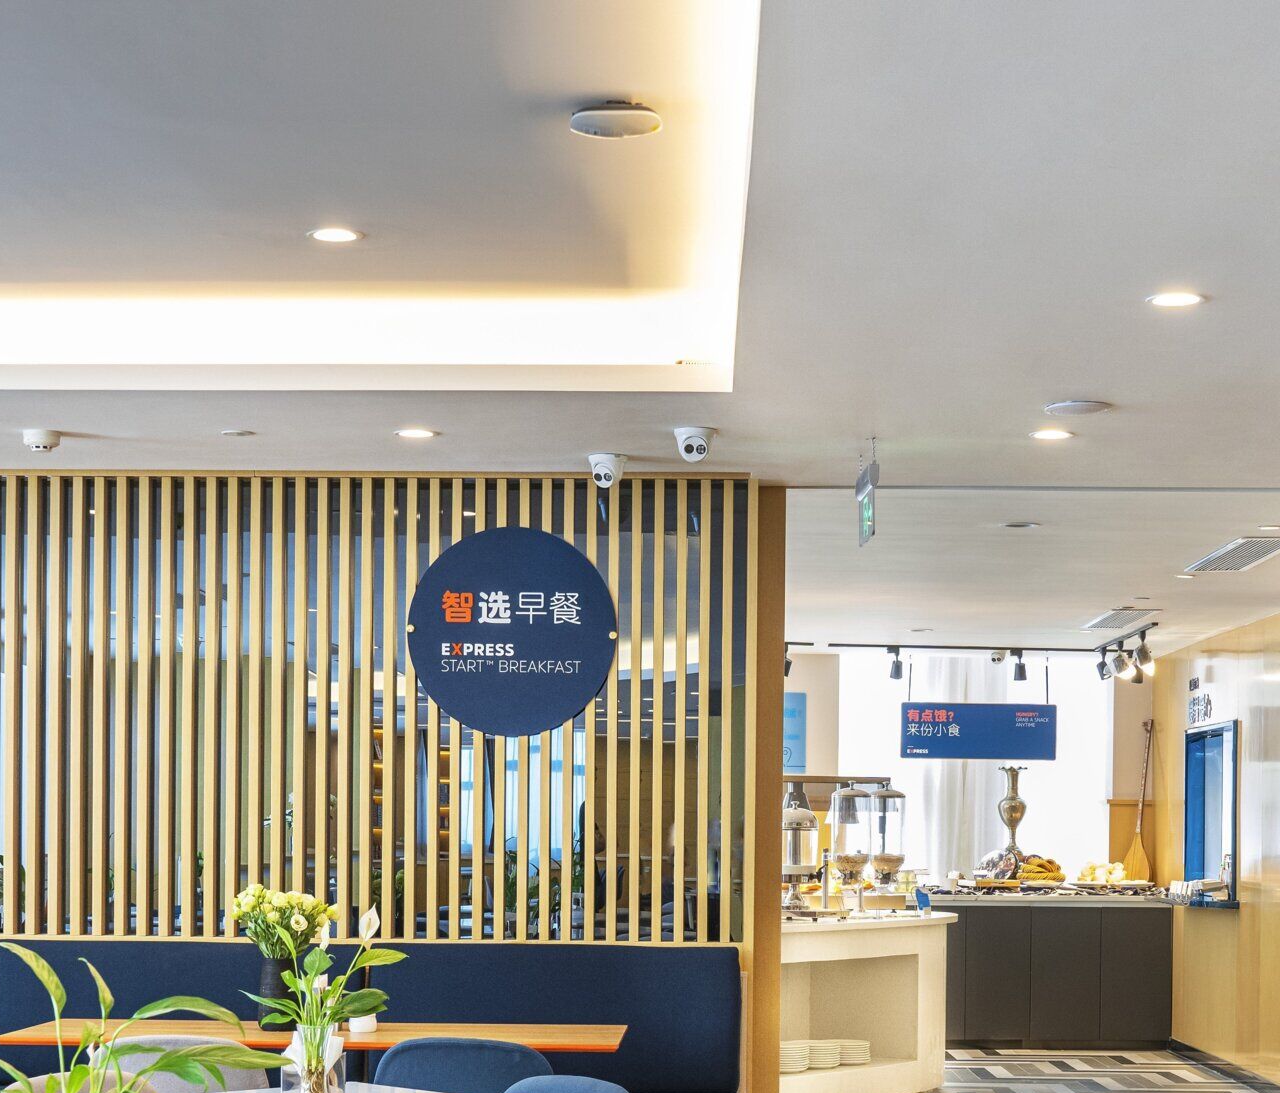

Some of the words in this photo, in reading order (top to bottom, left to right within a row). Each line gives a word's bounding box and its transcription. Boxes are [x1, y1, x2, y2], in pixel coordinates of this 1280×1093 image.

[441, 590, 582, 625] 智选早餐
[441, 643, 515, 657] EXPRESS
[498, 660, 582, 674] BREAKFAST
[907, 723, 960, 737] 来份小食
